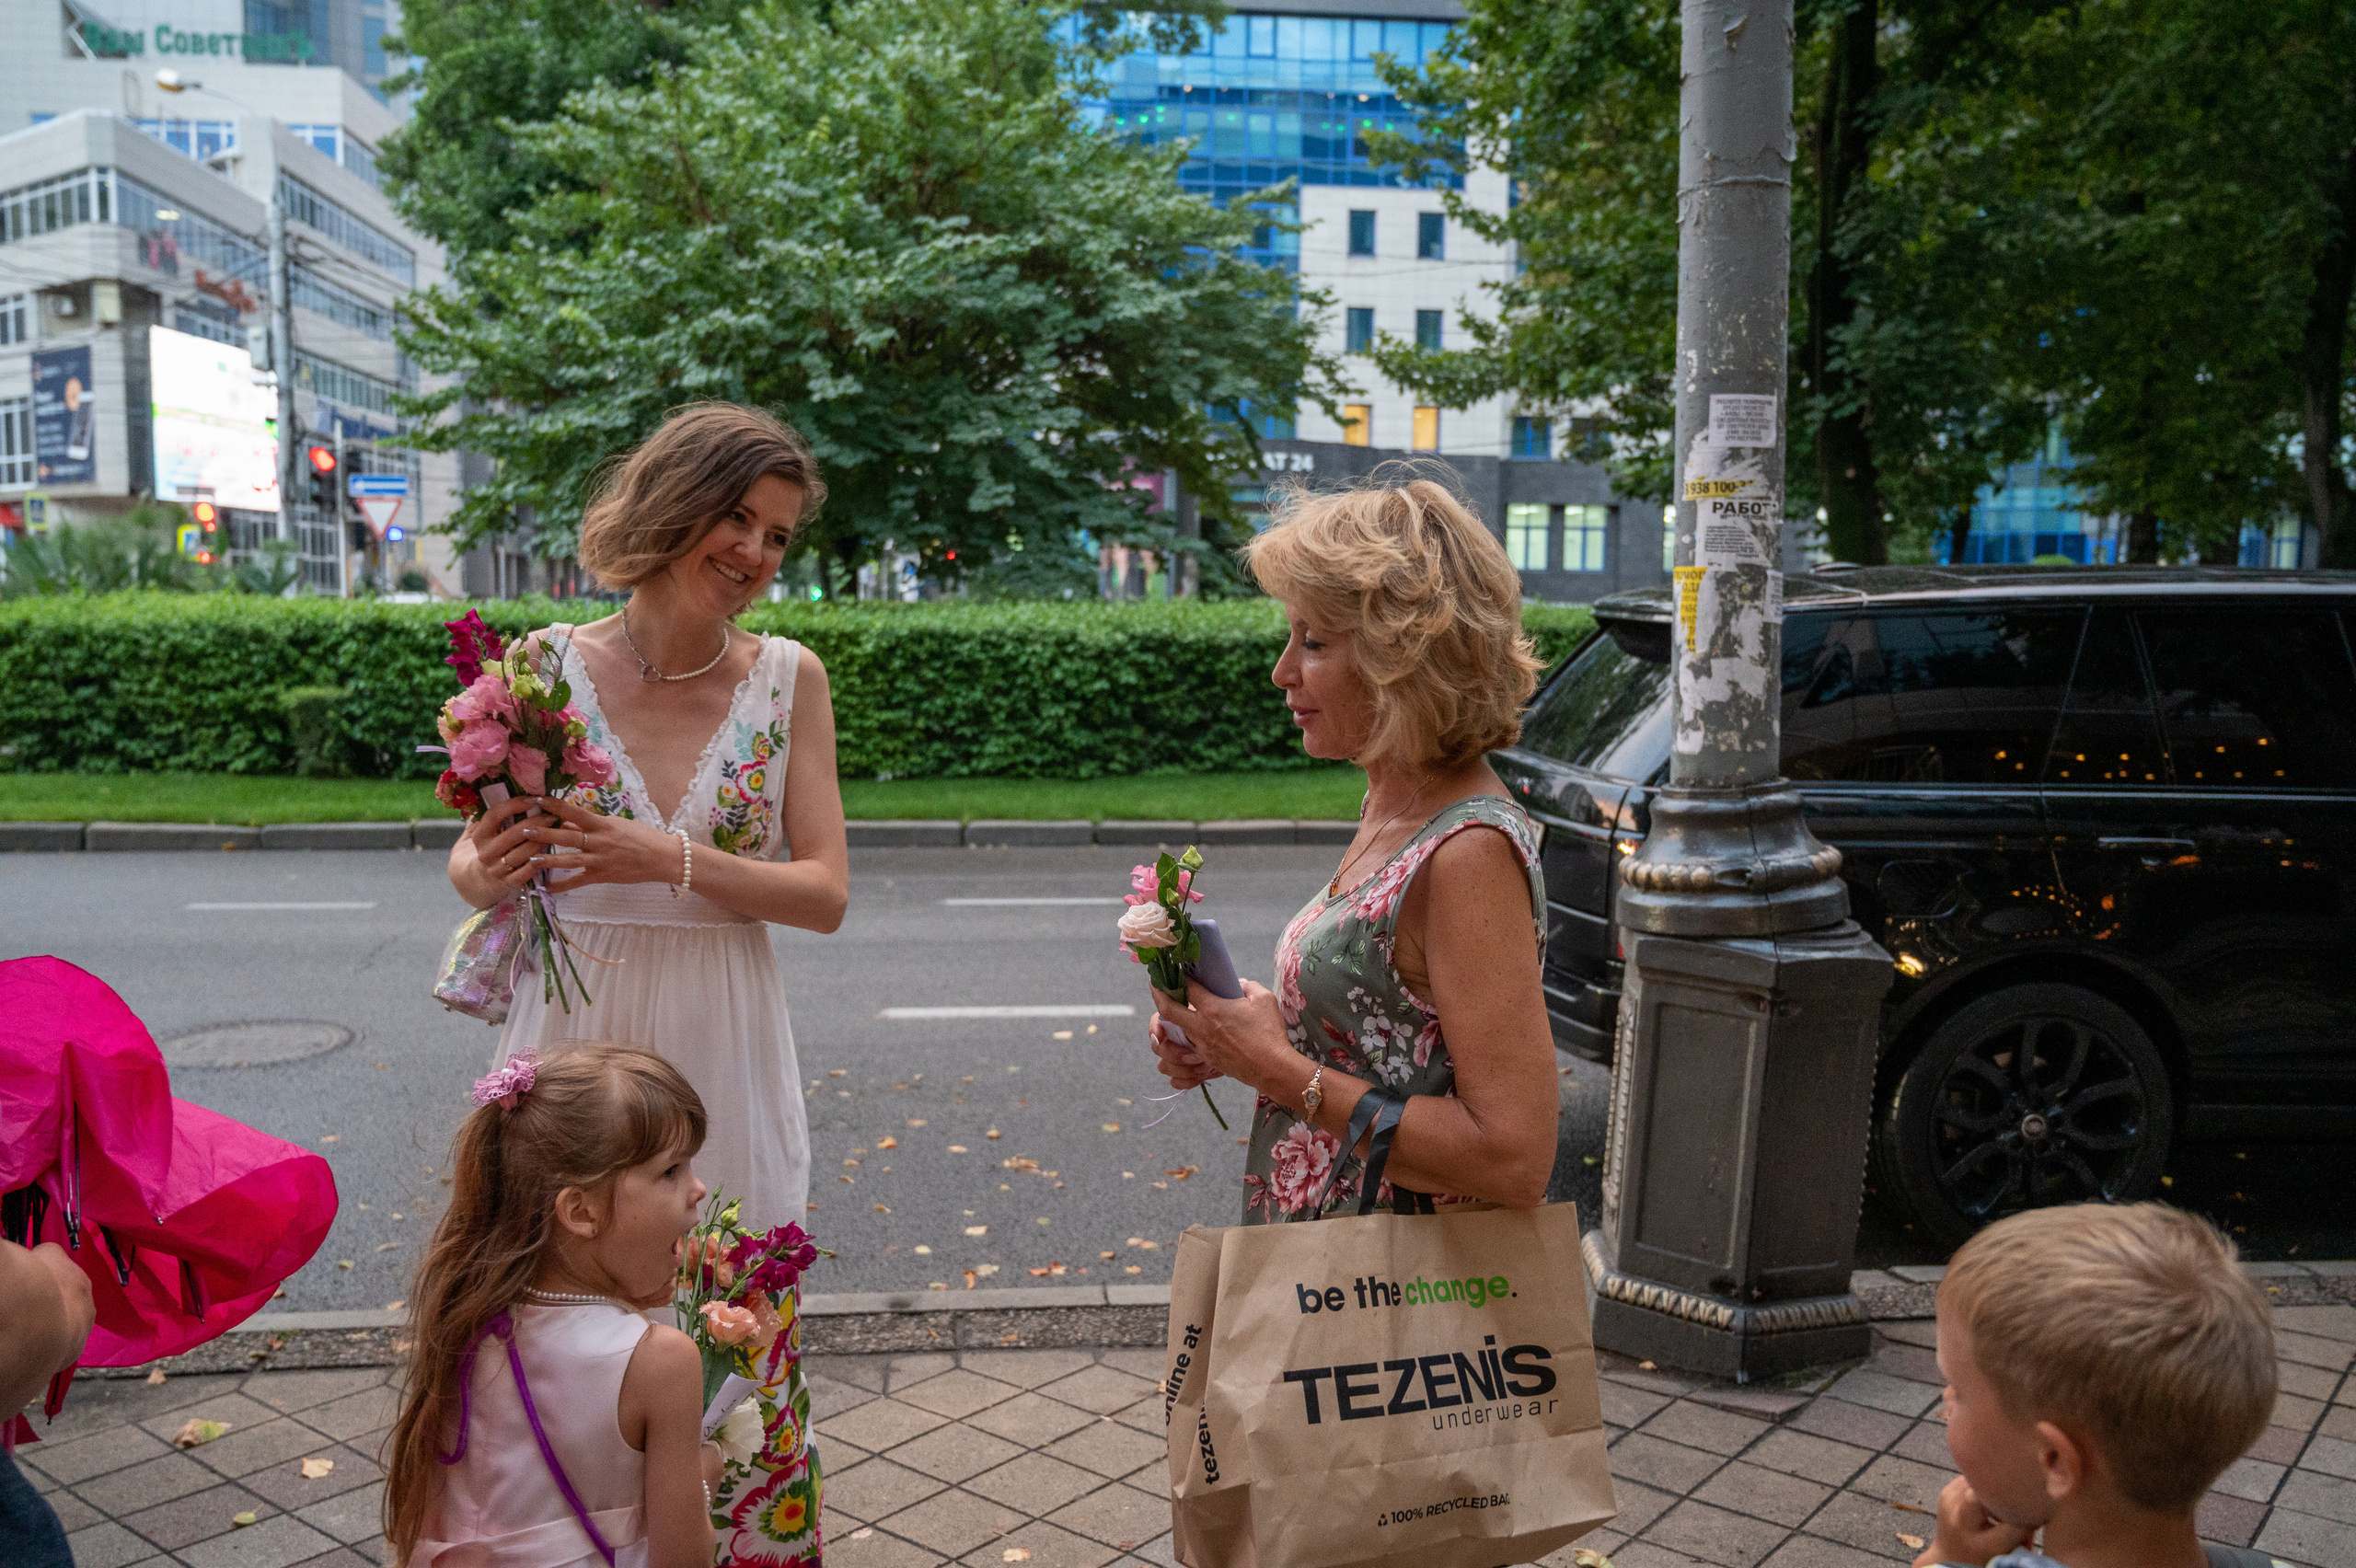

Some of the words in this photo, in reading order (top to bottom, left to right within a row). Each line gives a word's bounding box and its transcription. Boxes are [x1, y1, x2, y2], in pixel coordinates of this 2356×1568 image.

[1296, 1283, 1345, 1314] be
[1354, 1275, 1402, 1309] the
[1404, 1275, 1518, 1309] change.
[1183, 1323, 1203, 1350] at
[1432, 1397, 1559, 1431] underwear
[1198, 1405, 1220, 1485] tezen
[1391, 1506, 1424, 1524] 100%
[1426, 1496, 1489, 1517] RECYCLED
